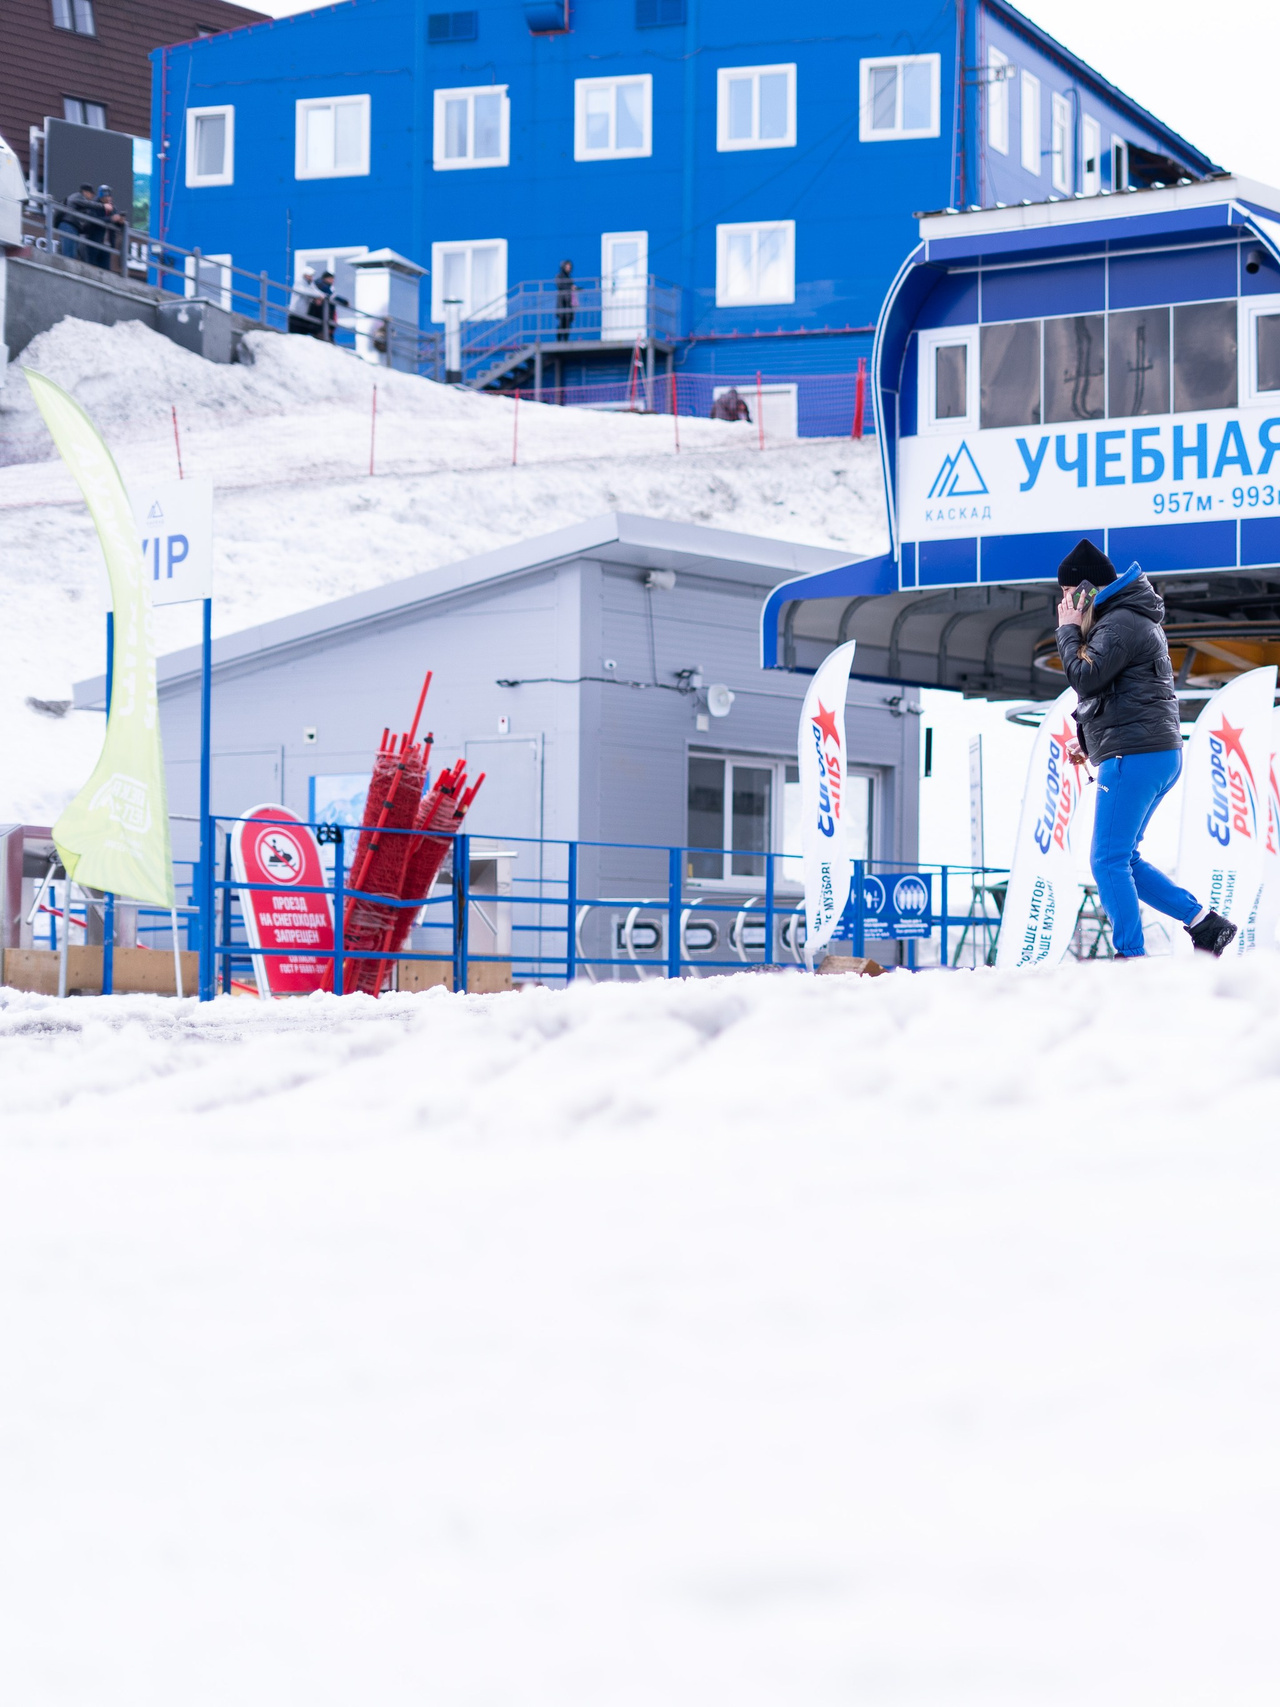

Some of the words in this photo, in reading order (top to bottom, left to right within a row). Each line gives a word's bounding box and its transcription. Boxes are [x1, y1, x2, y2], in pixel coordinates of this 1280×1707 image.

[925, 506, 991, 521] КАСКАД
[1029, 876, 1046, 921] ХИТОВ!
[1208, 869, 1224, 912] ХИТОВ!
[272, 896, 308, 912] ПРОЕЗД
[259, 913, 273, 926] НА
[273, 913, 327, 928] СНЕГОХОДАХ
[273, 929, 320, 945] ЗАПРЕЩЕН
